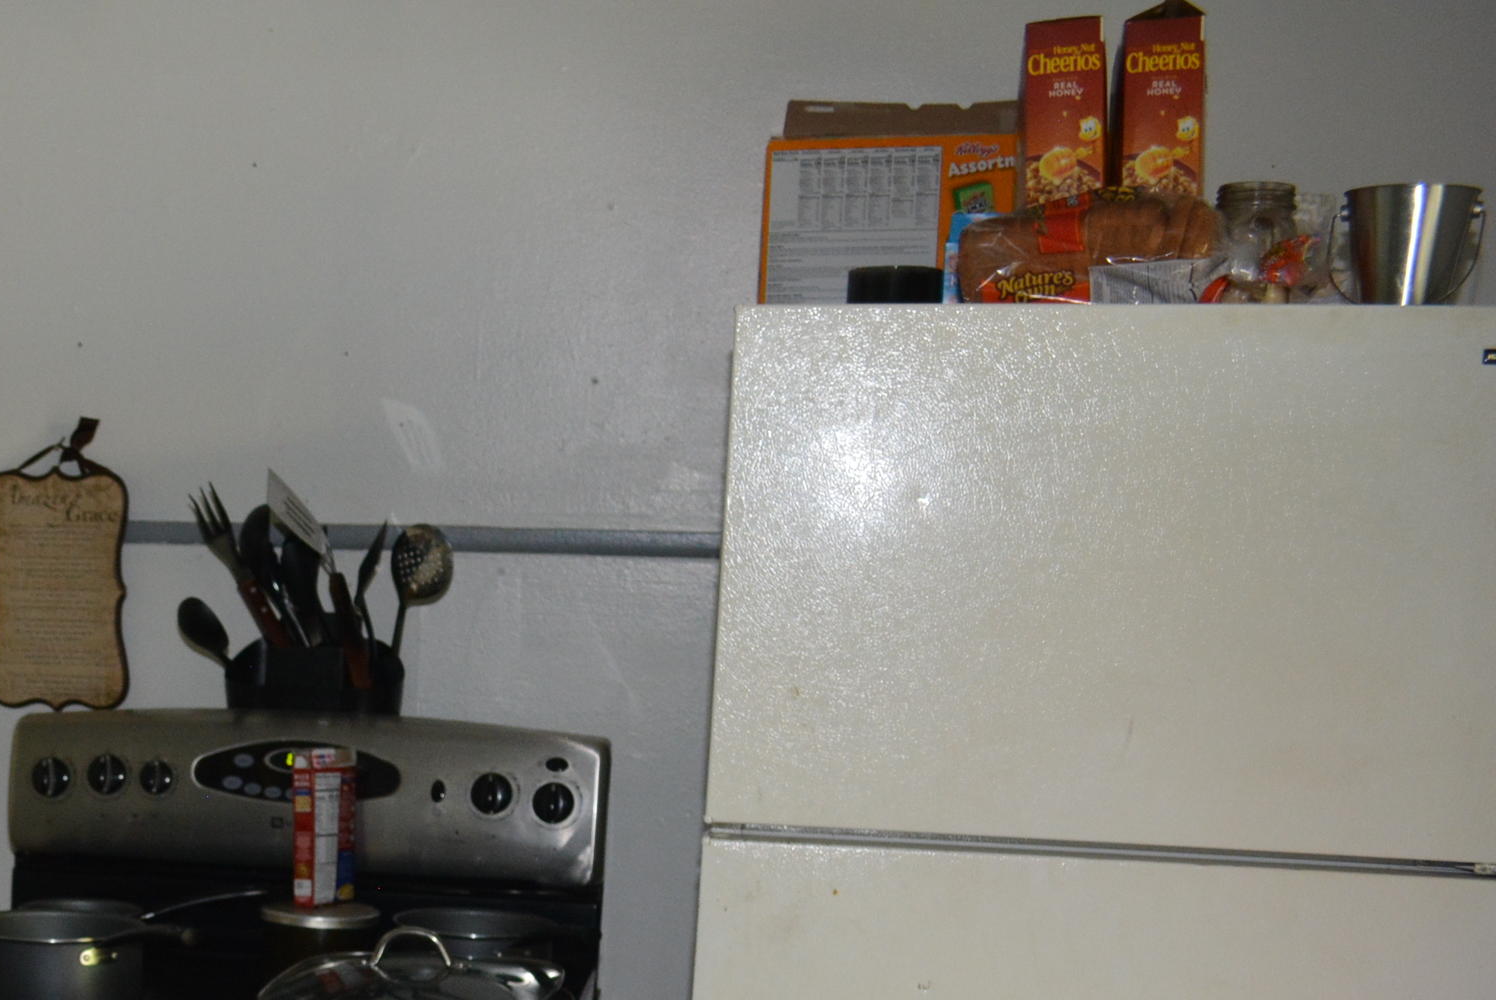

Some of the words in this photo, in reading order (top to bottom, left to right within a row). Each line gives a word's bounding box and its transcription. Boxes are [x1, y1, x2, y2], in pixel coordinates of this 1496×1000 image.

[1080, 43, 1097, 53] Nut
[1180, 42, 1197, 51] Nut
[1027, 53, 1101, 76] Cheerios
[1126, 52, 1201, 74] Cheerios
[1053, 81, 1078, 90] REAL
[1152, 80, 1177, 89] REAL
[1048, 88, 1084, 98] HONEY
[1147, 87, 1182, 97] HONEY
[997, 270, 1074, 299] Nature's
